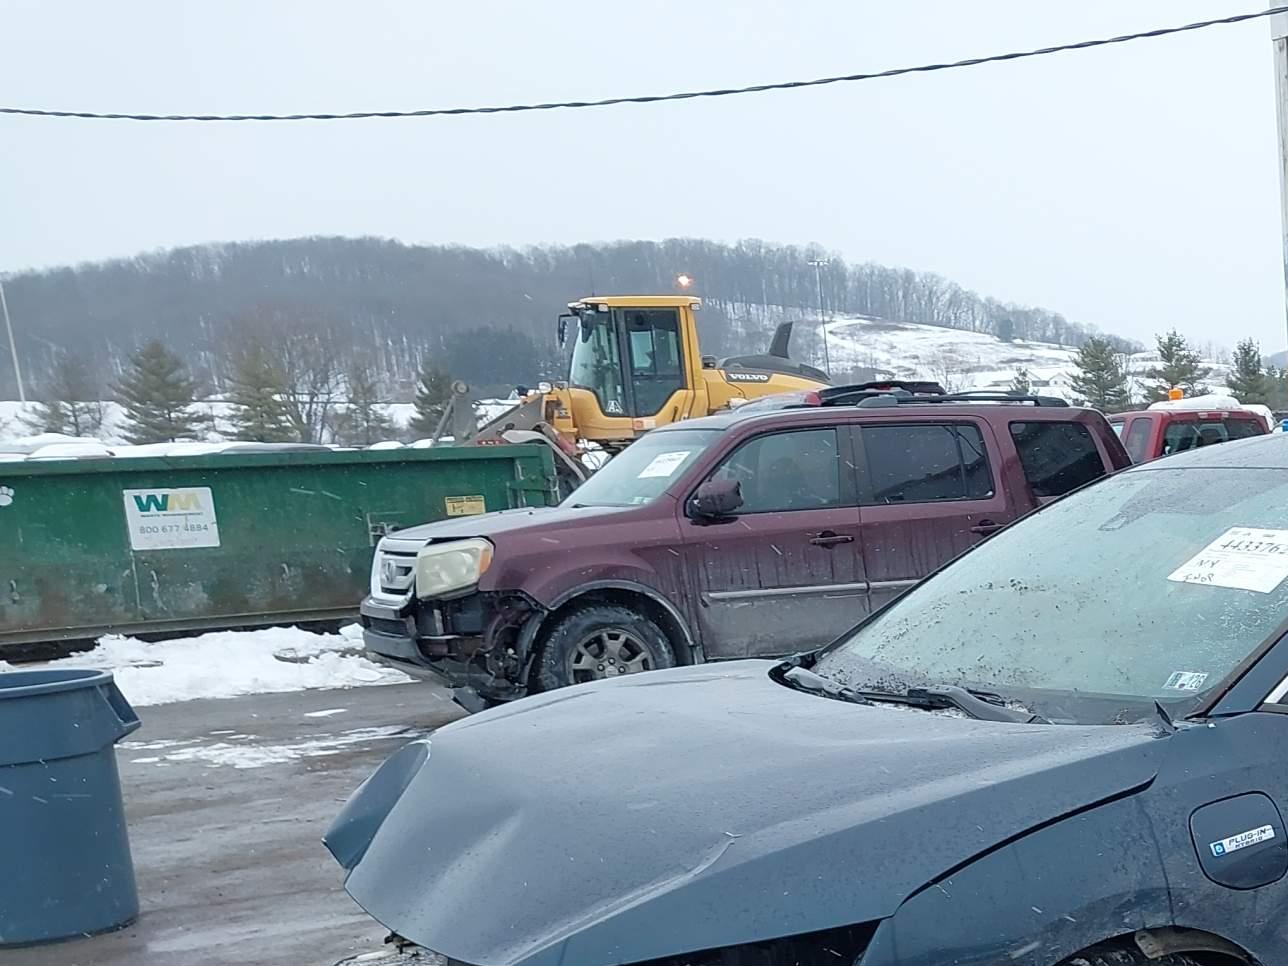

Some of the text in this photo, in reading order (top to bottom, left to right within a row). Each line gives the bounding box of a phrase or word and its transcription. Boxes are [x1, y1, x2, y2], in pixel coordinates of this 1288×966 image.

[727, 373, 769, 381] VOLVO
[133, 492, 203, 513] WM
[139, 526, 160, 535] 800
[161, 524, 180, 534] 677
